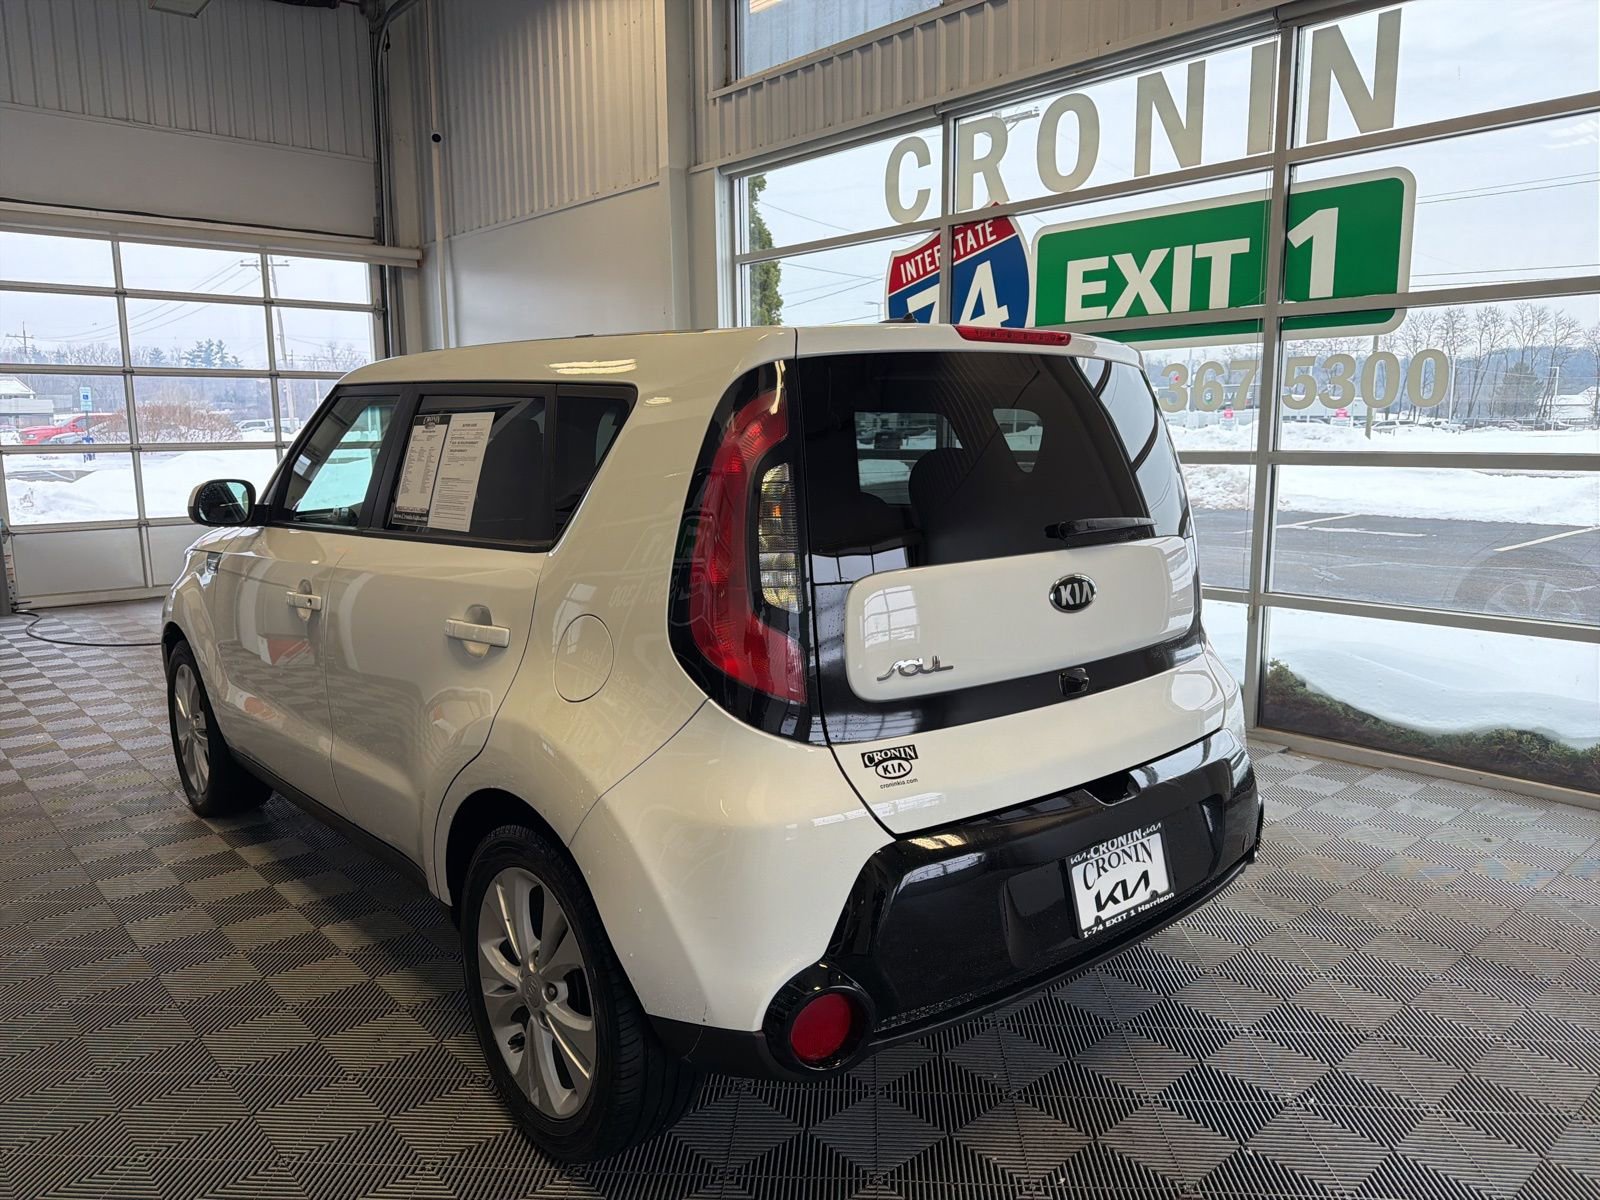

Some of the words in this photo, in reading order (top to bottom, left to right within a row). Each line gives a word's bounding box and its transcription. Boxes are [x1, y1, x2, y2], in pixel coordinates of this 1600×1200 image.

[884, 9, 1402, 224] CRONIN
[900, 219, 997, 284] INTERTATE
[1064, 237, 1250, 323] EXIT
[1287, 207, 1339, 300] 1
[907, 260, 1010, 327] 74
[1159, 358, 1262, 413] 367
[1282, 348, 1450, 411] 5300
[1060, 582, 1094, 606] KIA
[864, 746, 916, 767] CRONIN
[882, 762, 907, 775] KIA
[880, 778, 918, 789] croninkia.com
[1083, 838, 1153, 890] CRONIN
[1090, 828, 1142, 858] CRONIN
[1094, 869, 1150, 913] KIA
[1083, 923, 1104, 938] I-74
[1105, 911, 1128, 927] EXIT
[1129, 908, 1137, 916] 1
[1138, 892, 1175, 912] Harrison
